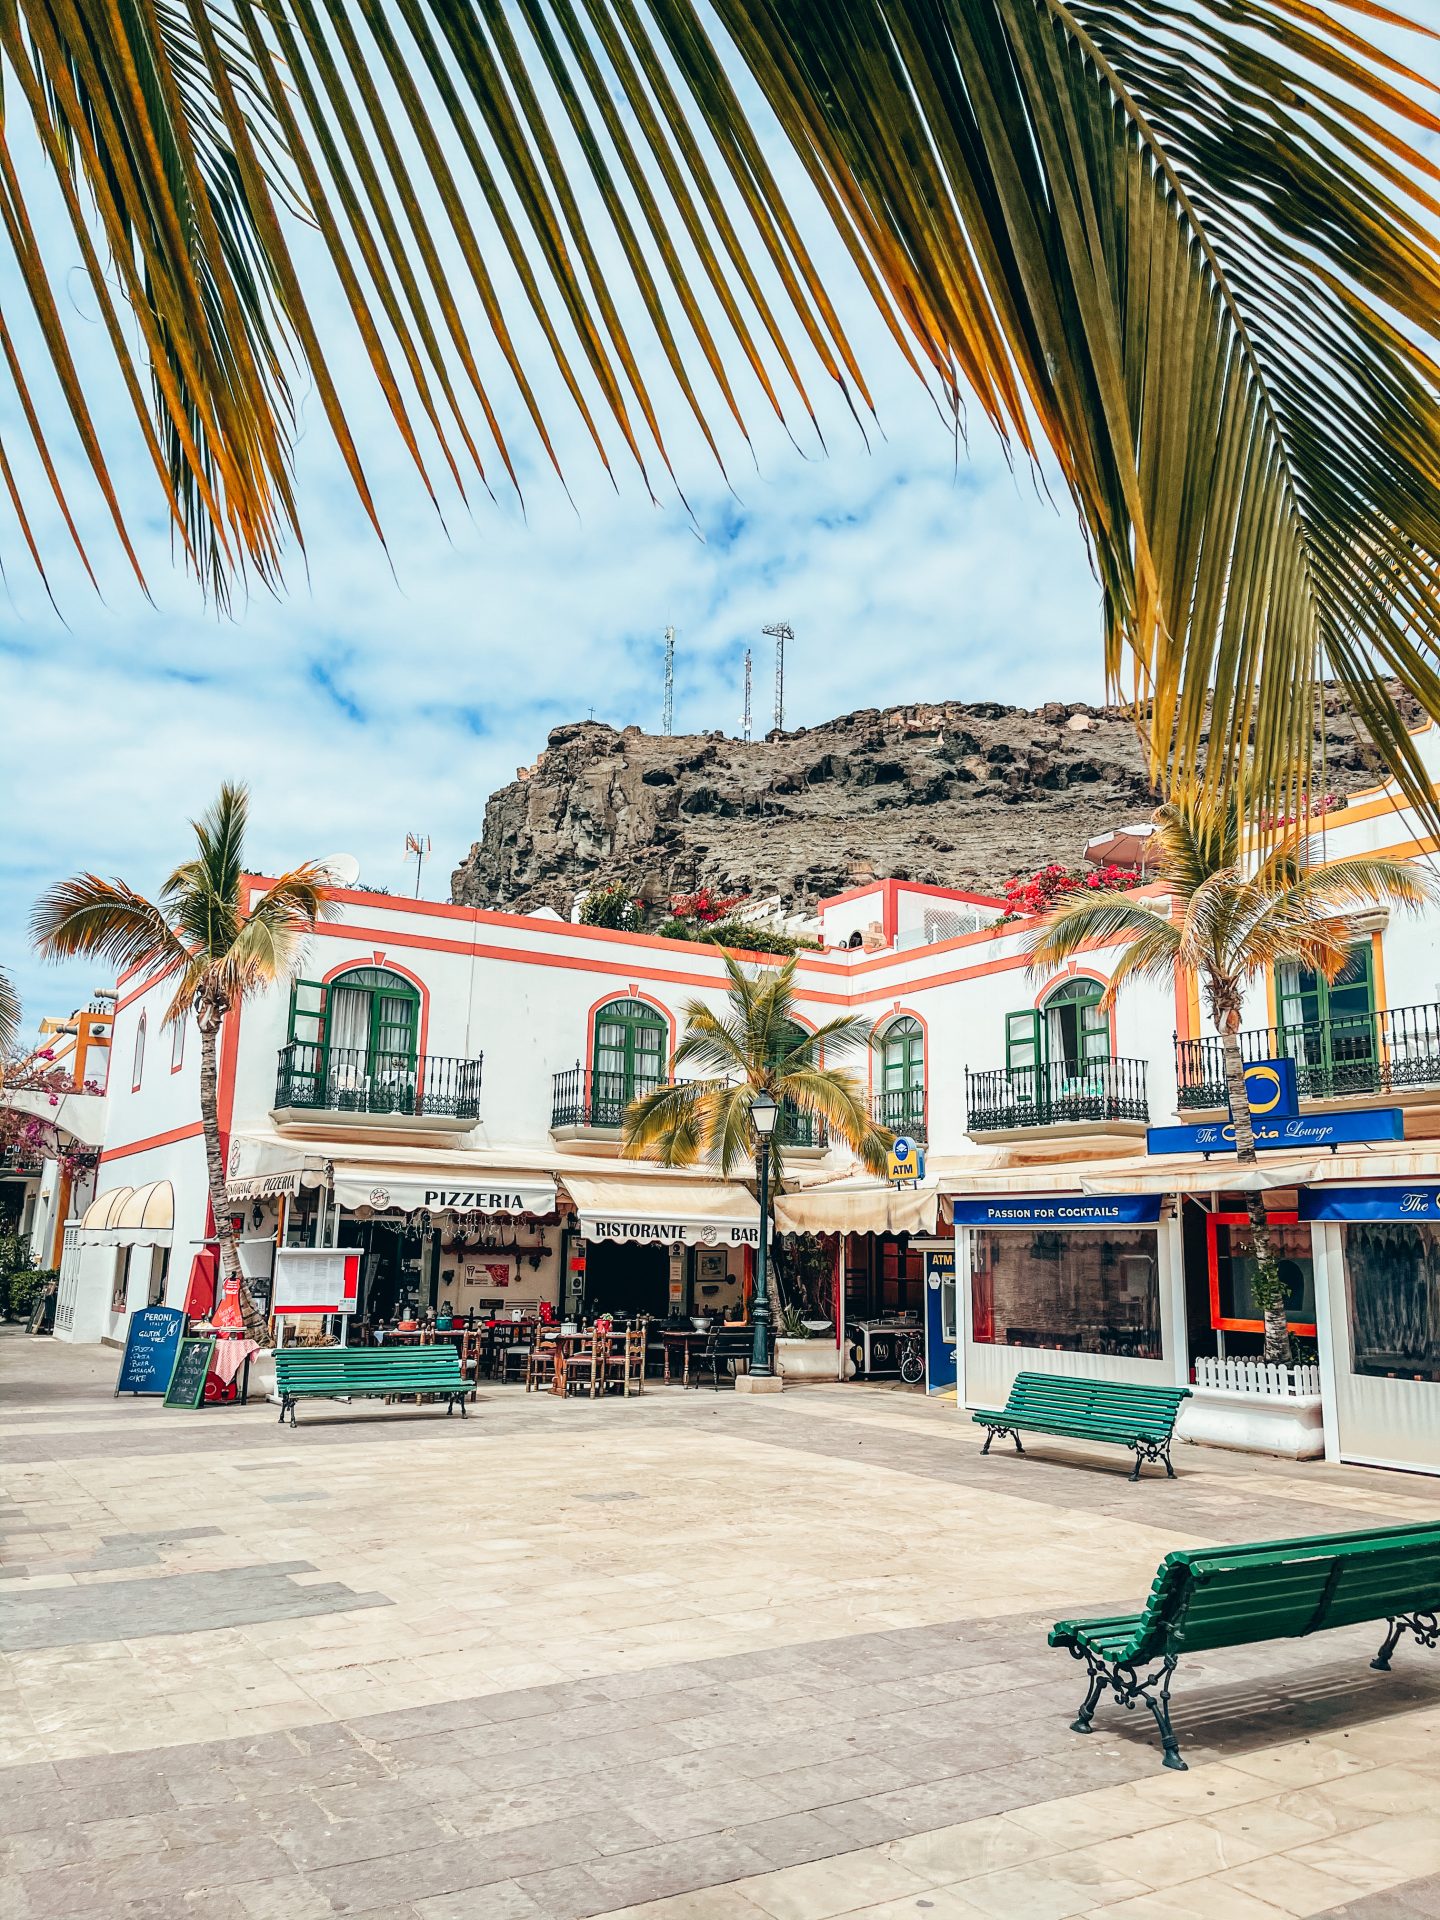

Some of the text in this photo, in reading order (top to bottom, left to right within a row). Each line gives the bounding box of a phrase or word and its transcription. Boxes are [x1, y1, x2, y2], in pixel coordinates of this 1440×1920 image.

[1196, 1128, 1217, 1143] The
[1286, 1121, 1334, 1141] Lounge
[893, 1164, 913, 1175] ATM
[263, 1175, 295, 1191] PIZZERIA
[424, 1191, 524, 1209] PIZZERIA
[1400, 1193, 1429, 1212] The
[596, 1222, 758, 1242] RISTORANTE BAR
[932, 1254, 953, 1265] ATM
[144, 1313, 172, 1321] PERONI
